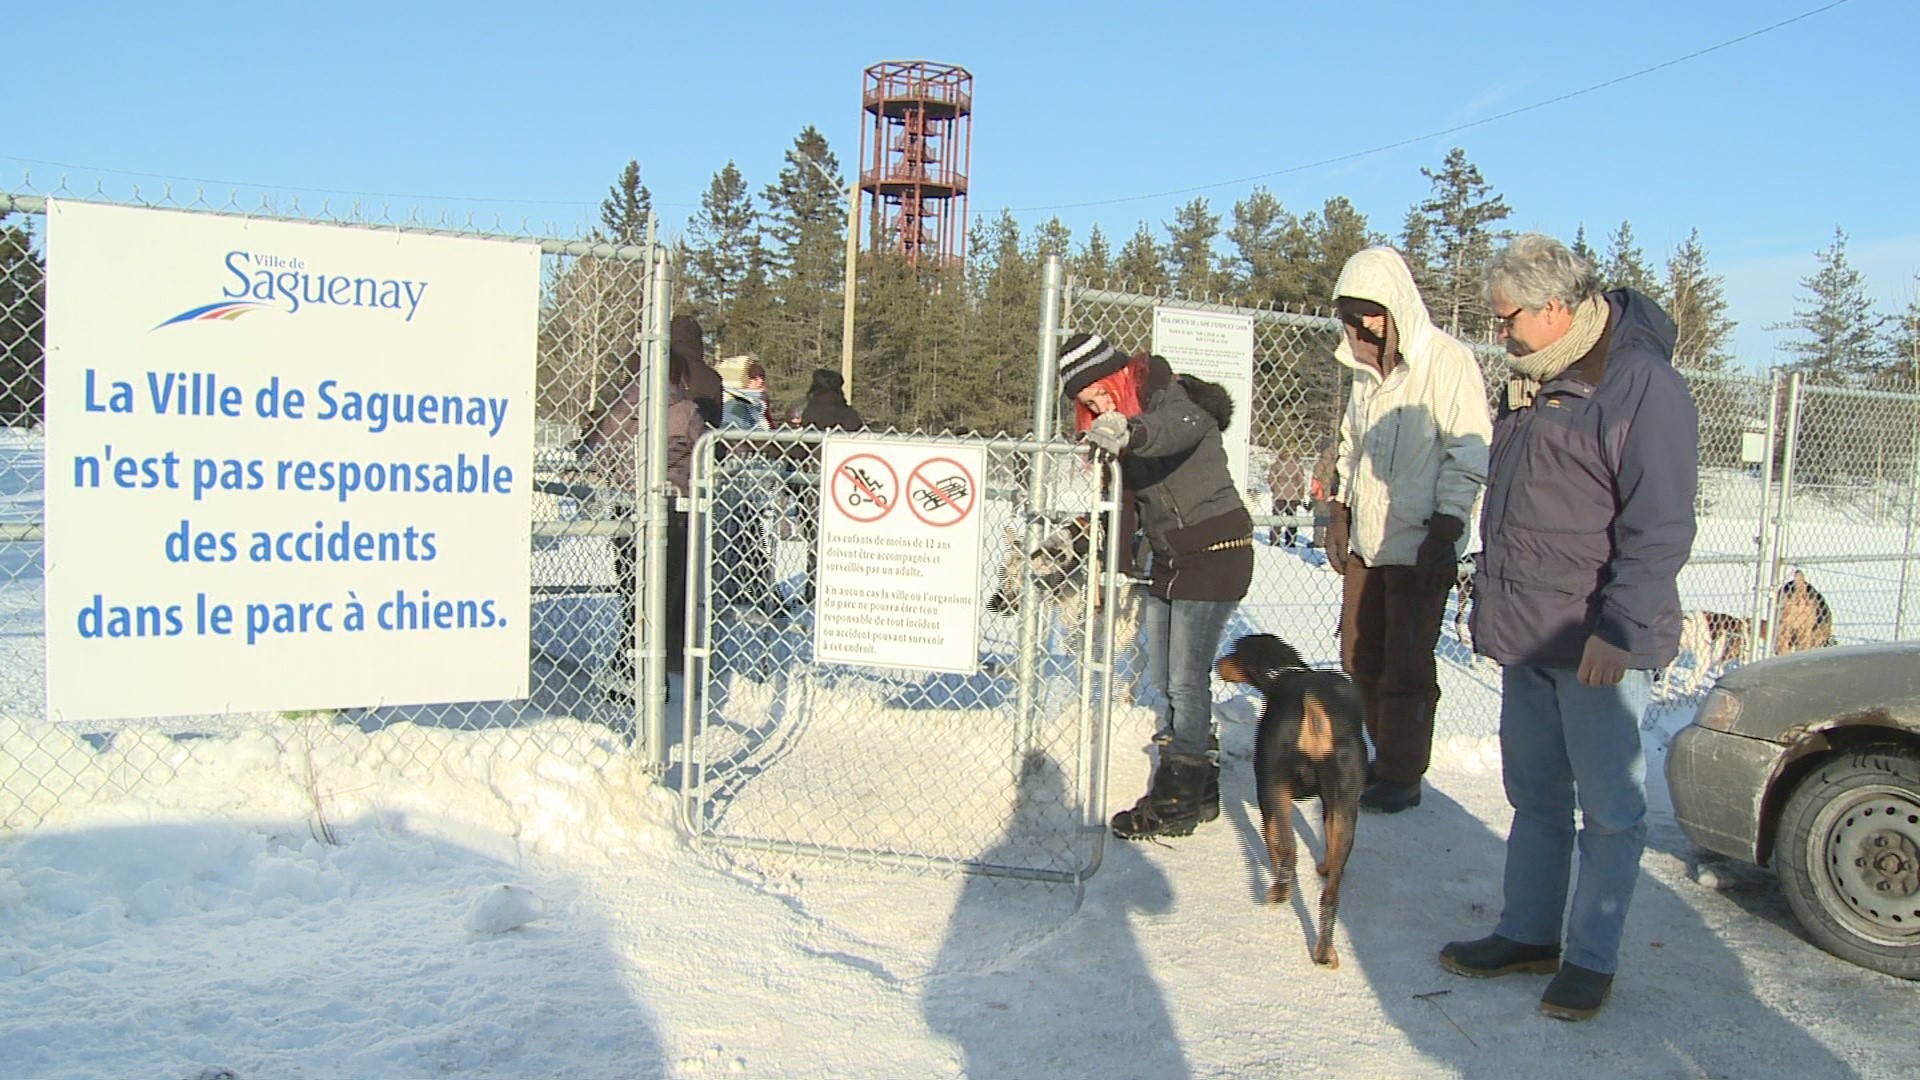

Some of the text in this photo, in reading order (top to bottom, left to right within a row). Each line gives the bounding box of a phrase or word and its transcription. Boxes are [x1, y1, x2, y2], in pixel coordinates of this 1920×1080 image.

[253, 253, 306, 270] Ville de
[222, 250, 429, 322] Saguenay
[85, 367, 509, 437] La Ville de Saguenay
[74, 445, 513, 503] n'est pas responsable
[165, 519, 437, 564] des accidents
[827, 531, 951, 550] Les enfants de moins de 12 ans
[826, 547, 857, 559] doivent
[932, 555, 941, 564] et
[865, 565, 880, 576] par
[882, 567, 893, 575] un
[825, 585, 837, 595] En
[839, 588, 865, 597] aucun
[866, 590, 880, 598] cas
[881, 589, 889, 599] la
[891, 589, 909, 600] ville
[824, 598, 836, 607] du
[837, 600, 856, 609] parc
[858, 601, 868, 610] ne
[870, 604, 899, 613] pourra
[919, 605, 938, 615] tenu
[77, 590, 508, 646] dans le parc à chiens.
[824, 613, 940, 630] responsable de tout incident
[823, 628, 944, 645] ou accident pouvant survenir
[830, 642, 842, 651] cet
